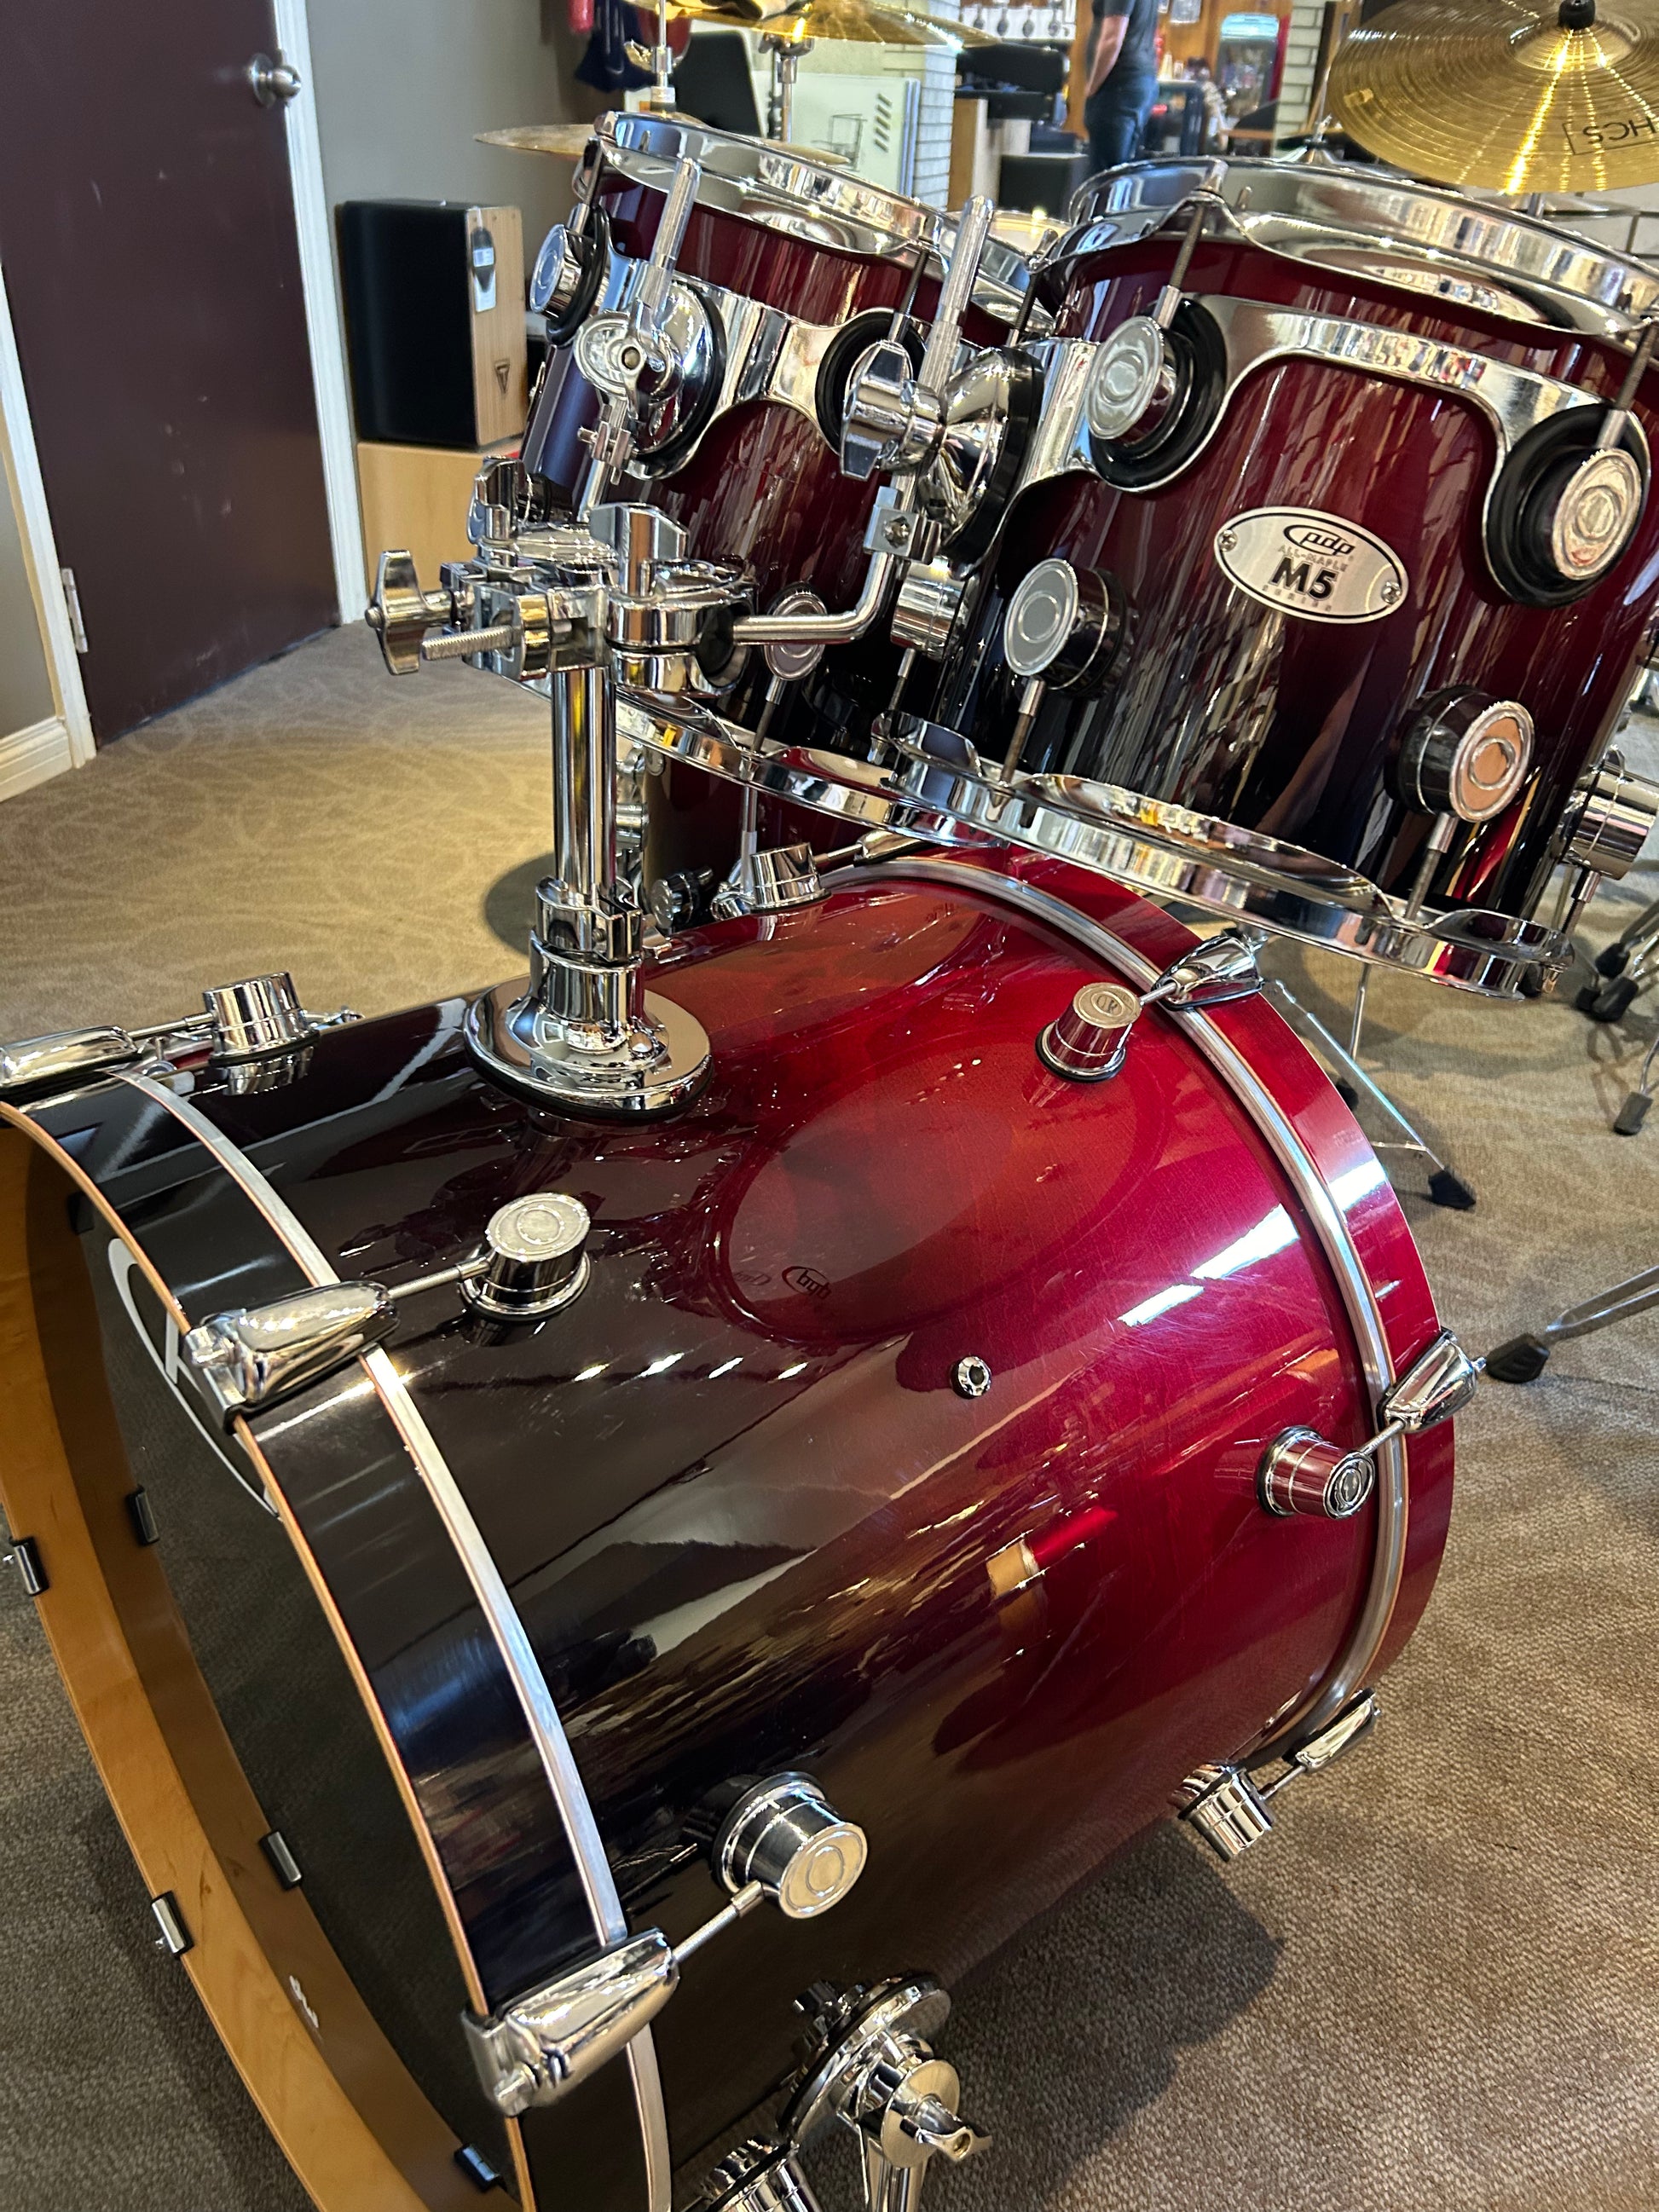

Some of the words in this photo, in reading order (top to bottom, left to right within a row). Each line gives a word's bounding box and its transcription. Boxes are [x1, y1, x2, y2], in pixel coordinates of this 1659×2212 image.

[1582, 116, 1656, 144] HCS
[1298, 530, 1356, 556] pdp
[1269, 554, 1339, 601] M5
